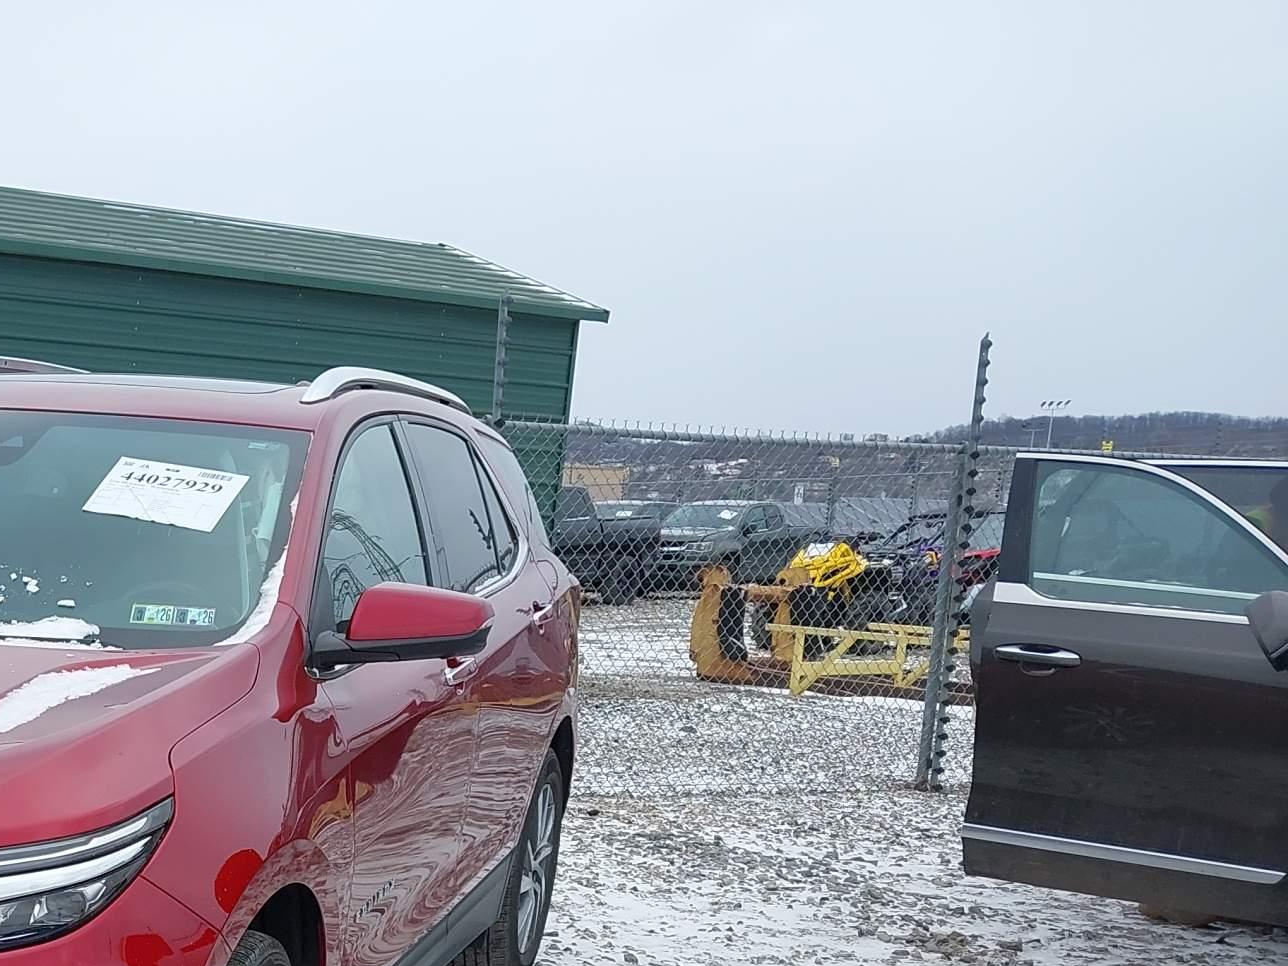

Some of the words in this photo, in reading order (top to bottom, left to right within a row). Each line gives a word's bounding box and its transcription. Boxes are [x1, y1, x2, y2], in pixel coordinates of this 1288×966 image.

[120, 470, 224, 494] 44027929
[160, 607, 172, 622] 26
[202, 610, 214, 624] 26
